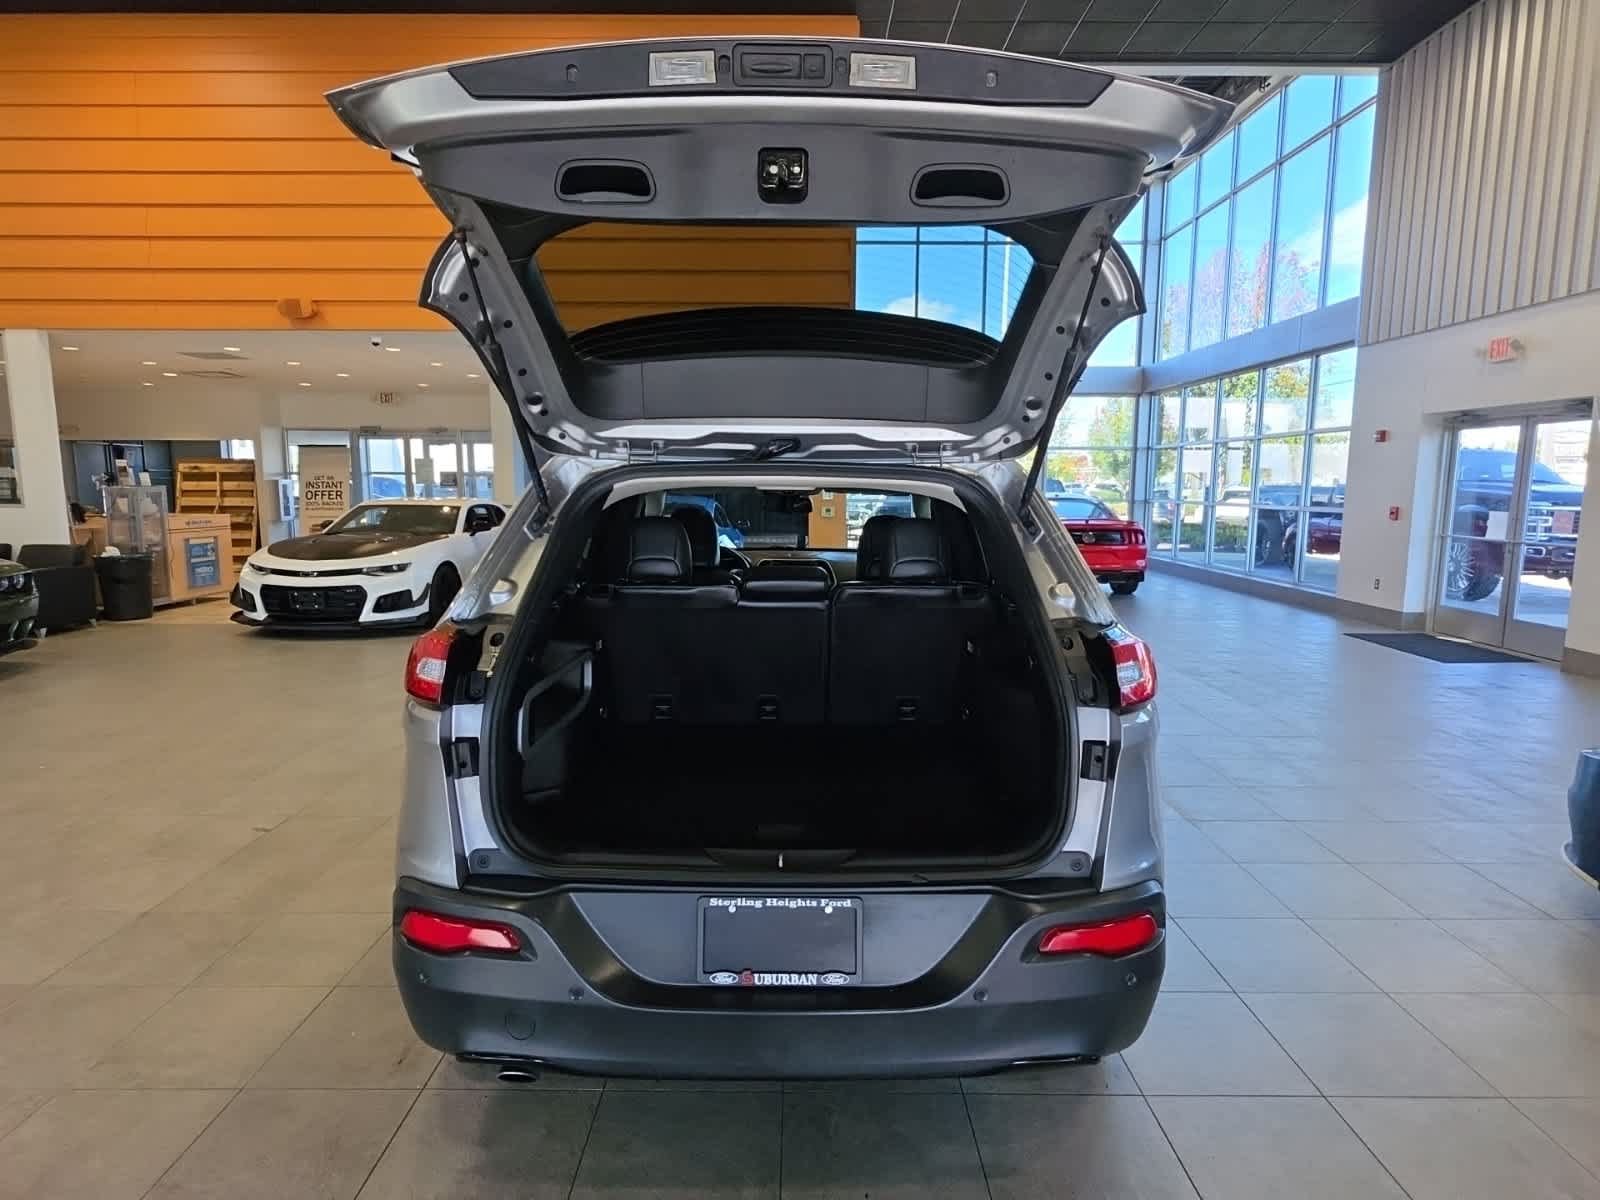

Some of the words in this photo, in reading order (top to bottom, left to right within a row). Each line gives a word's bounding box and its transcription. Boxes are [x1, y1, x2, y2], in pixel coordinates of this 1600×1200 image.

[1490, 338, 1510, 358] EXIT
[380, 392, 393, 403] EXIT
[306, 481, 343, 489] INSTANT
[305, 490, 343, 500] OFFER
[709, 898, 763, 908] Sterling
[766, 898, 817, 908] Heights
[820, 899, 852, 908] Ford
[742, 970, 818, 986] SUBURBAN
